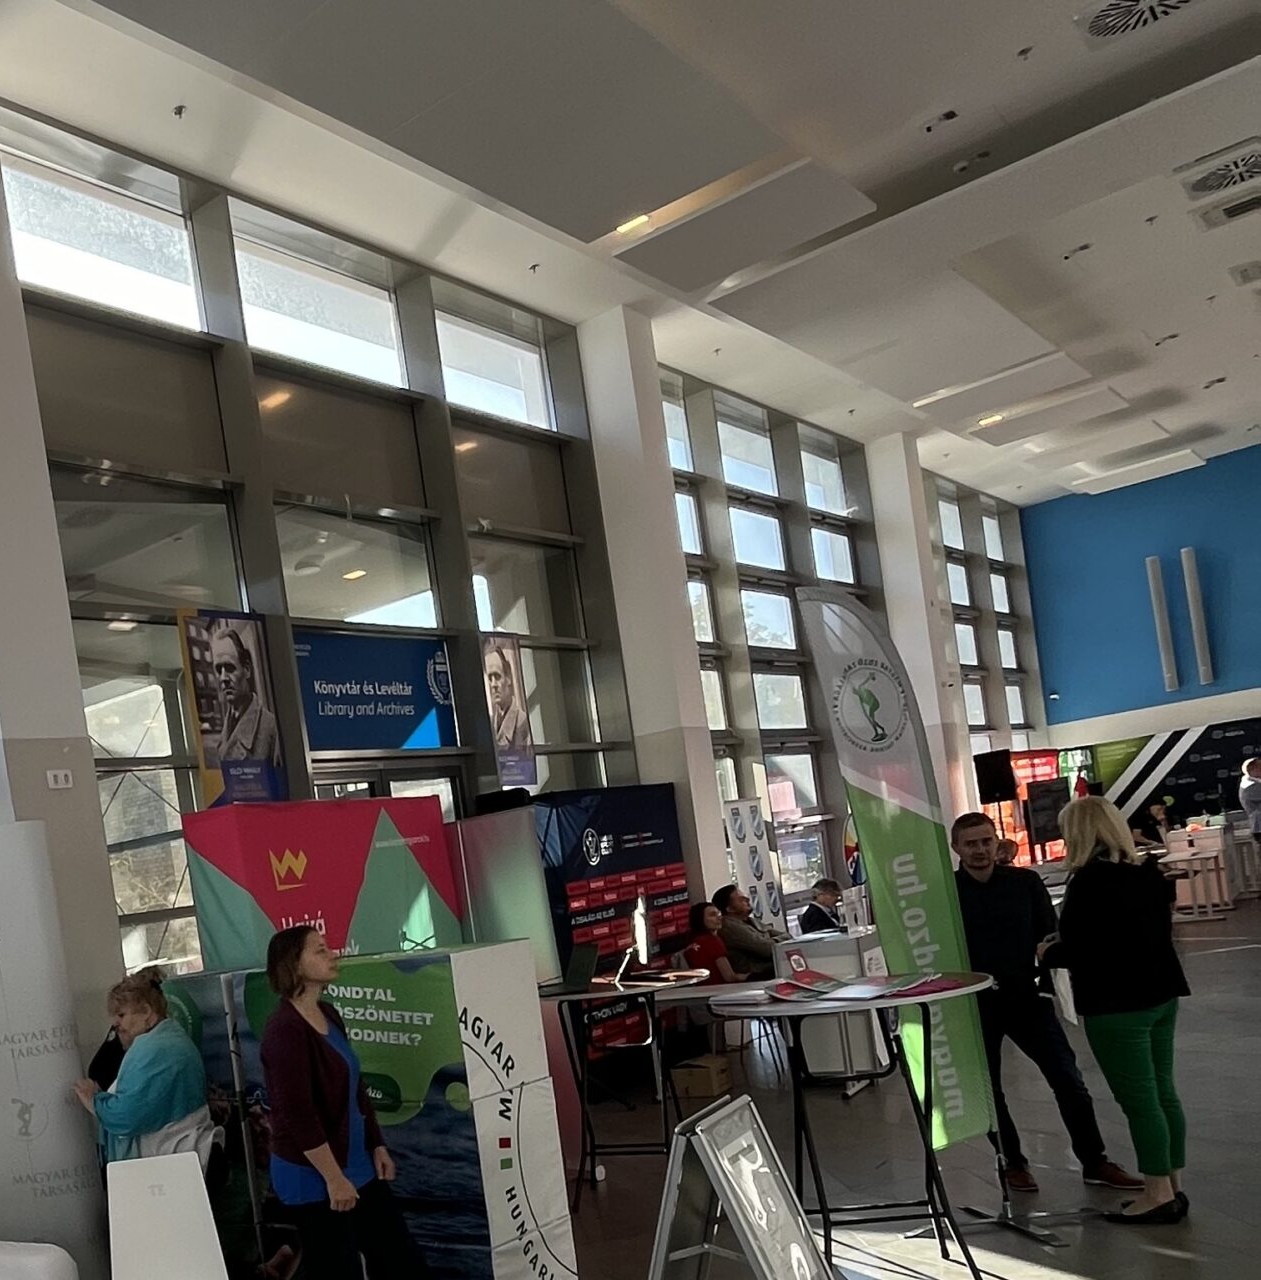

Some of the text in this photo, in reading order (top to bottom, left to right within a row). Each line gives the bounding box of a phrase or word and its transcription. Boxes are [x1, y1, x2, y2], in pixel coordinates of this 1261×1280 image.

[313, 679, 413, 697] Könyvtár és Levéltár
[318, 701, 416, 719] Library and Archives
[323, 983, 397, 1002] ONDTAL
